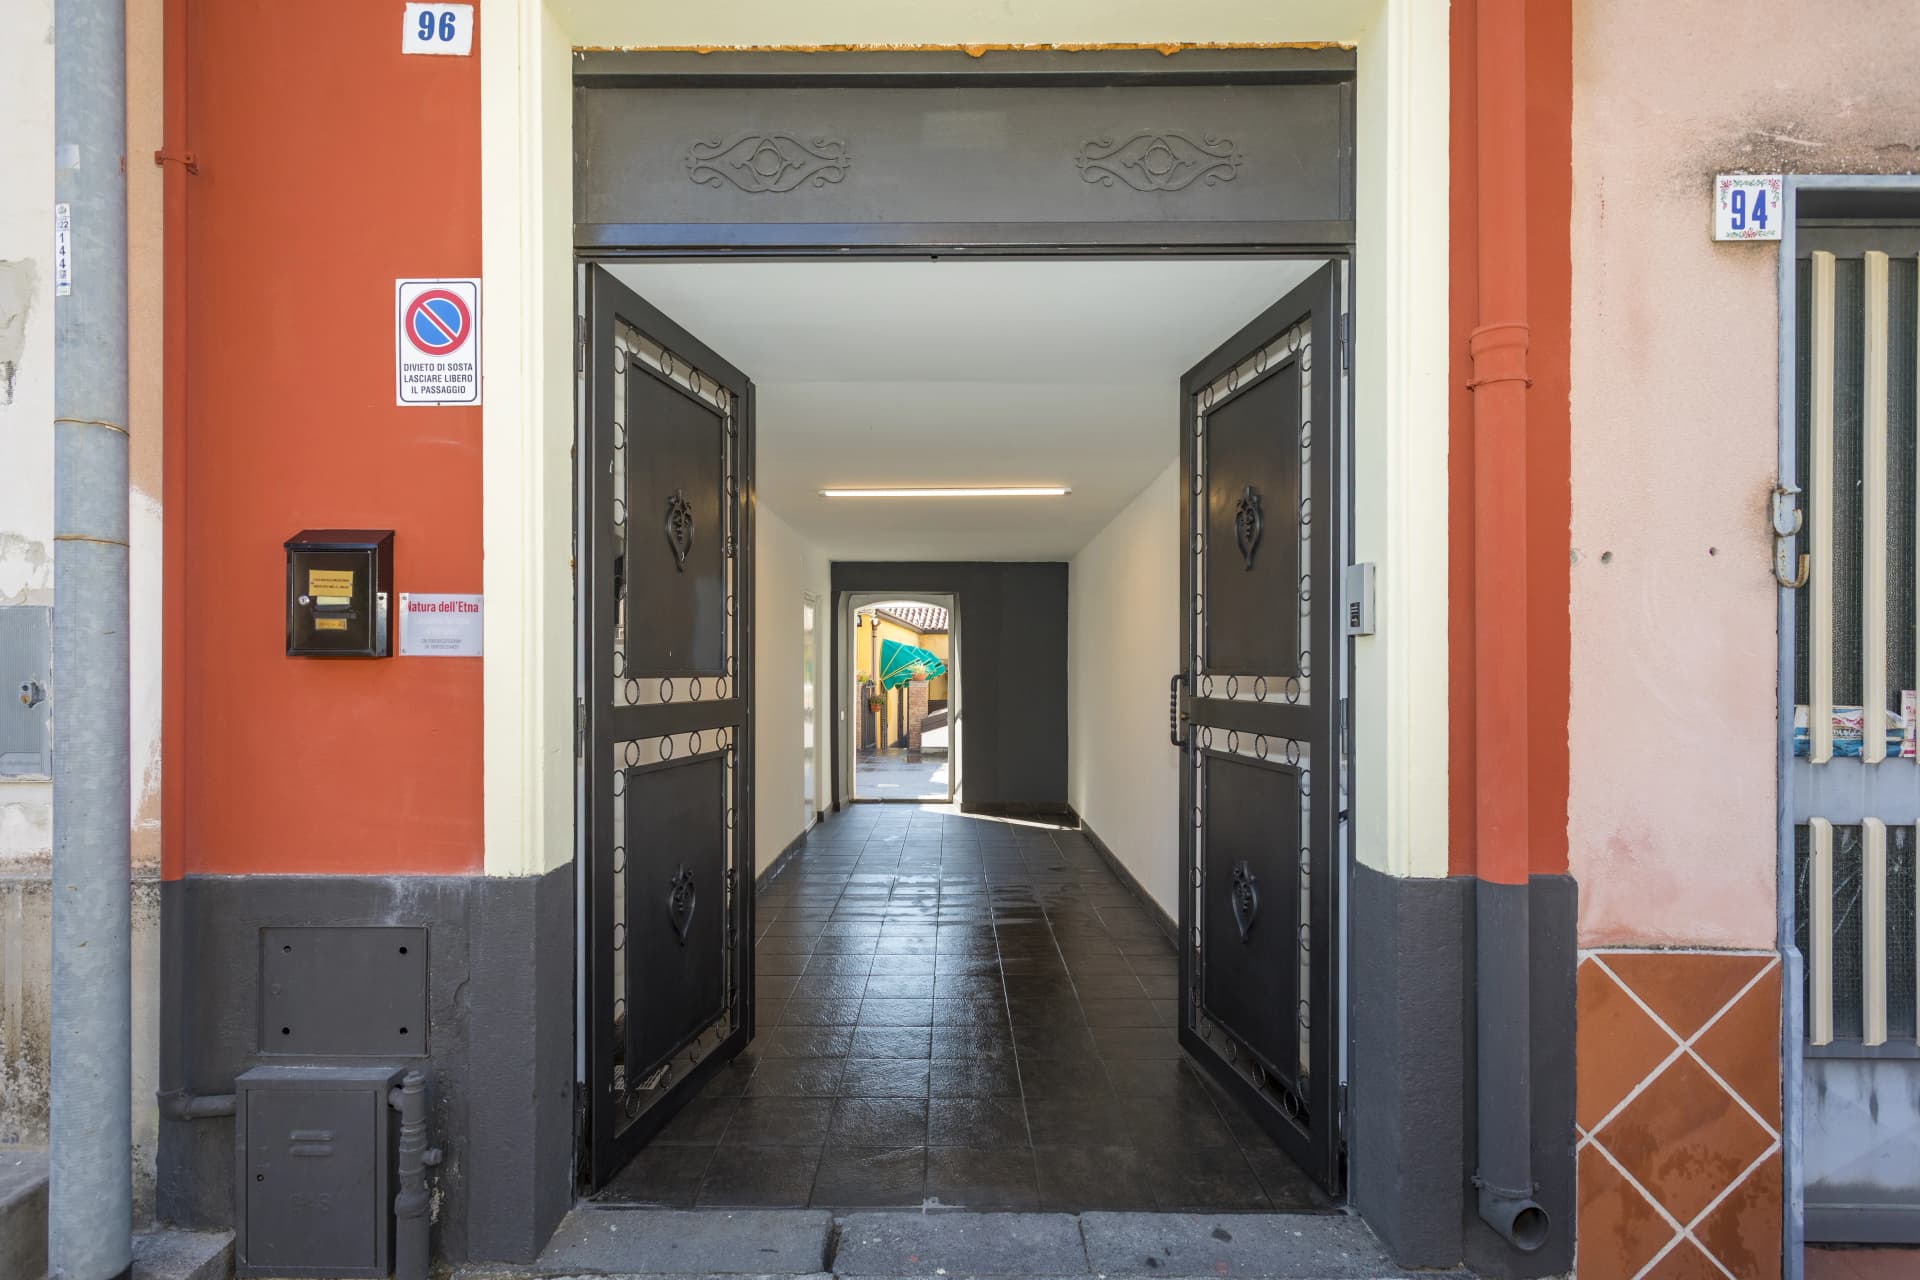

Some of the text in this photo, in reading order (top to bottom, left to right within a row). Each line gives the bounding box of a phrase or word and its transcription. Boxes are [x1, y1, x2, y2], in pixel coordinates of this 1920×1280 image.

[418, 10, 456, 42] 96
[1731, 189, 1768, 230] 94
[403, 363, 473, 372] DIVIETO DI SOSTA
[404, 374, 473, 383] LASCIARE LIBERO
[411, 385, 466, 394] IL PASSAGGIO
[438, 601, 479, 613] dell'Etna
